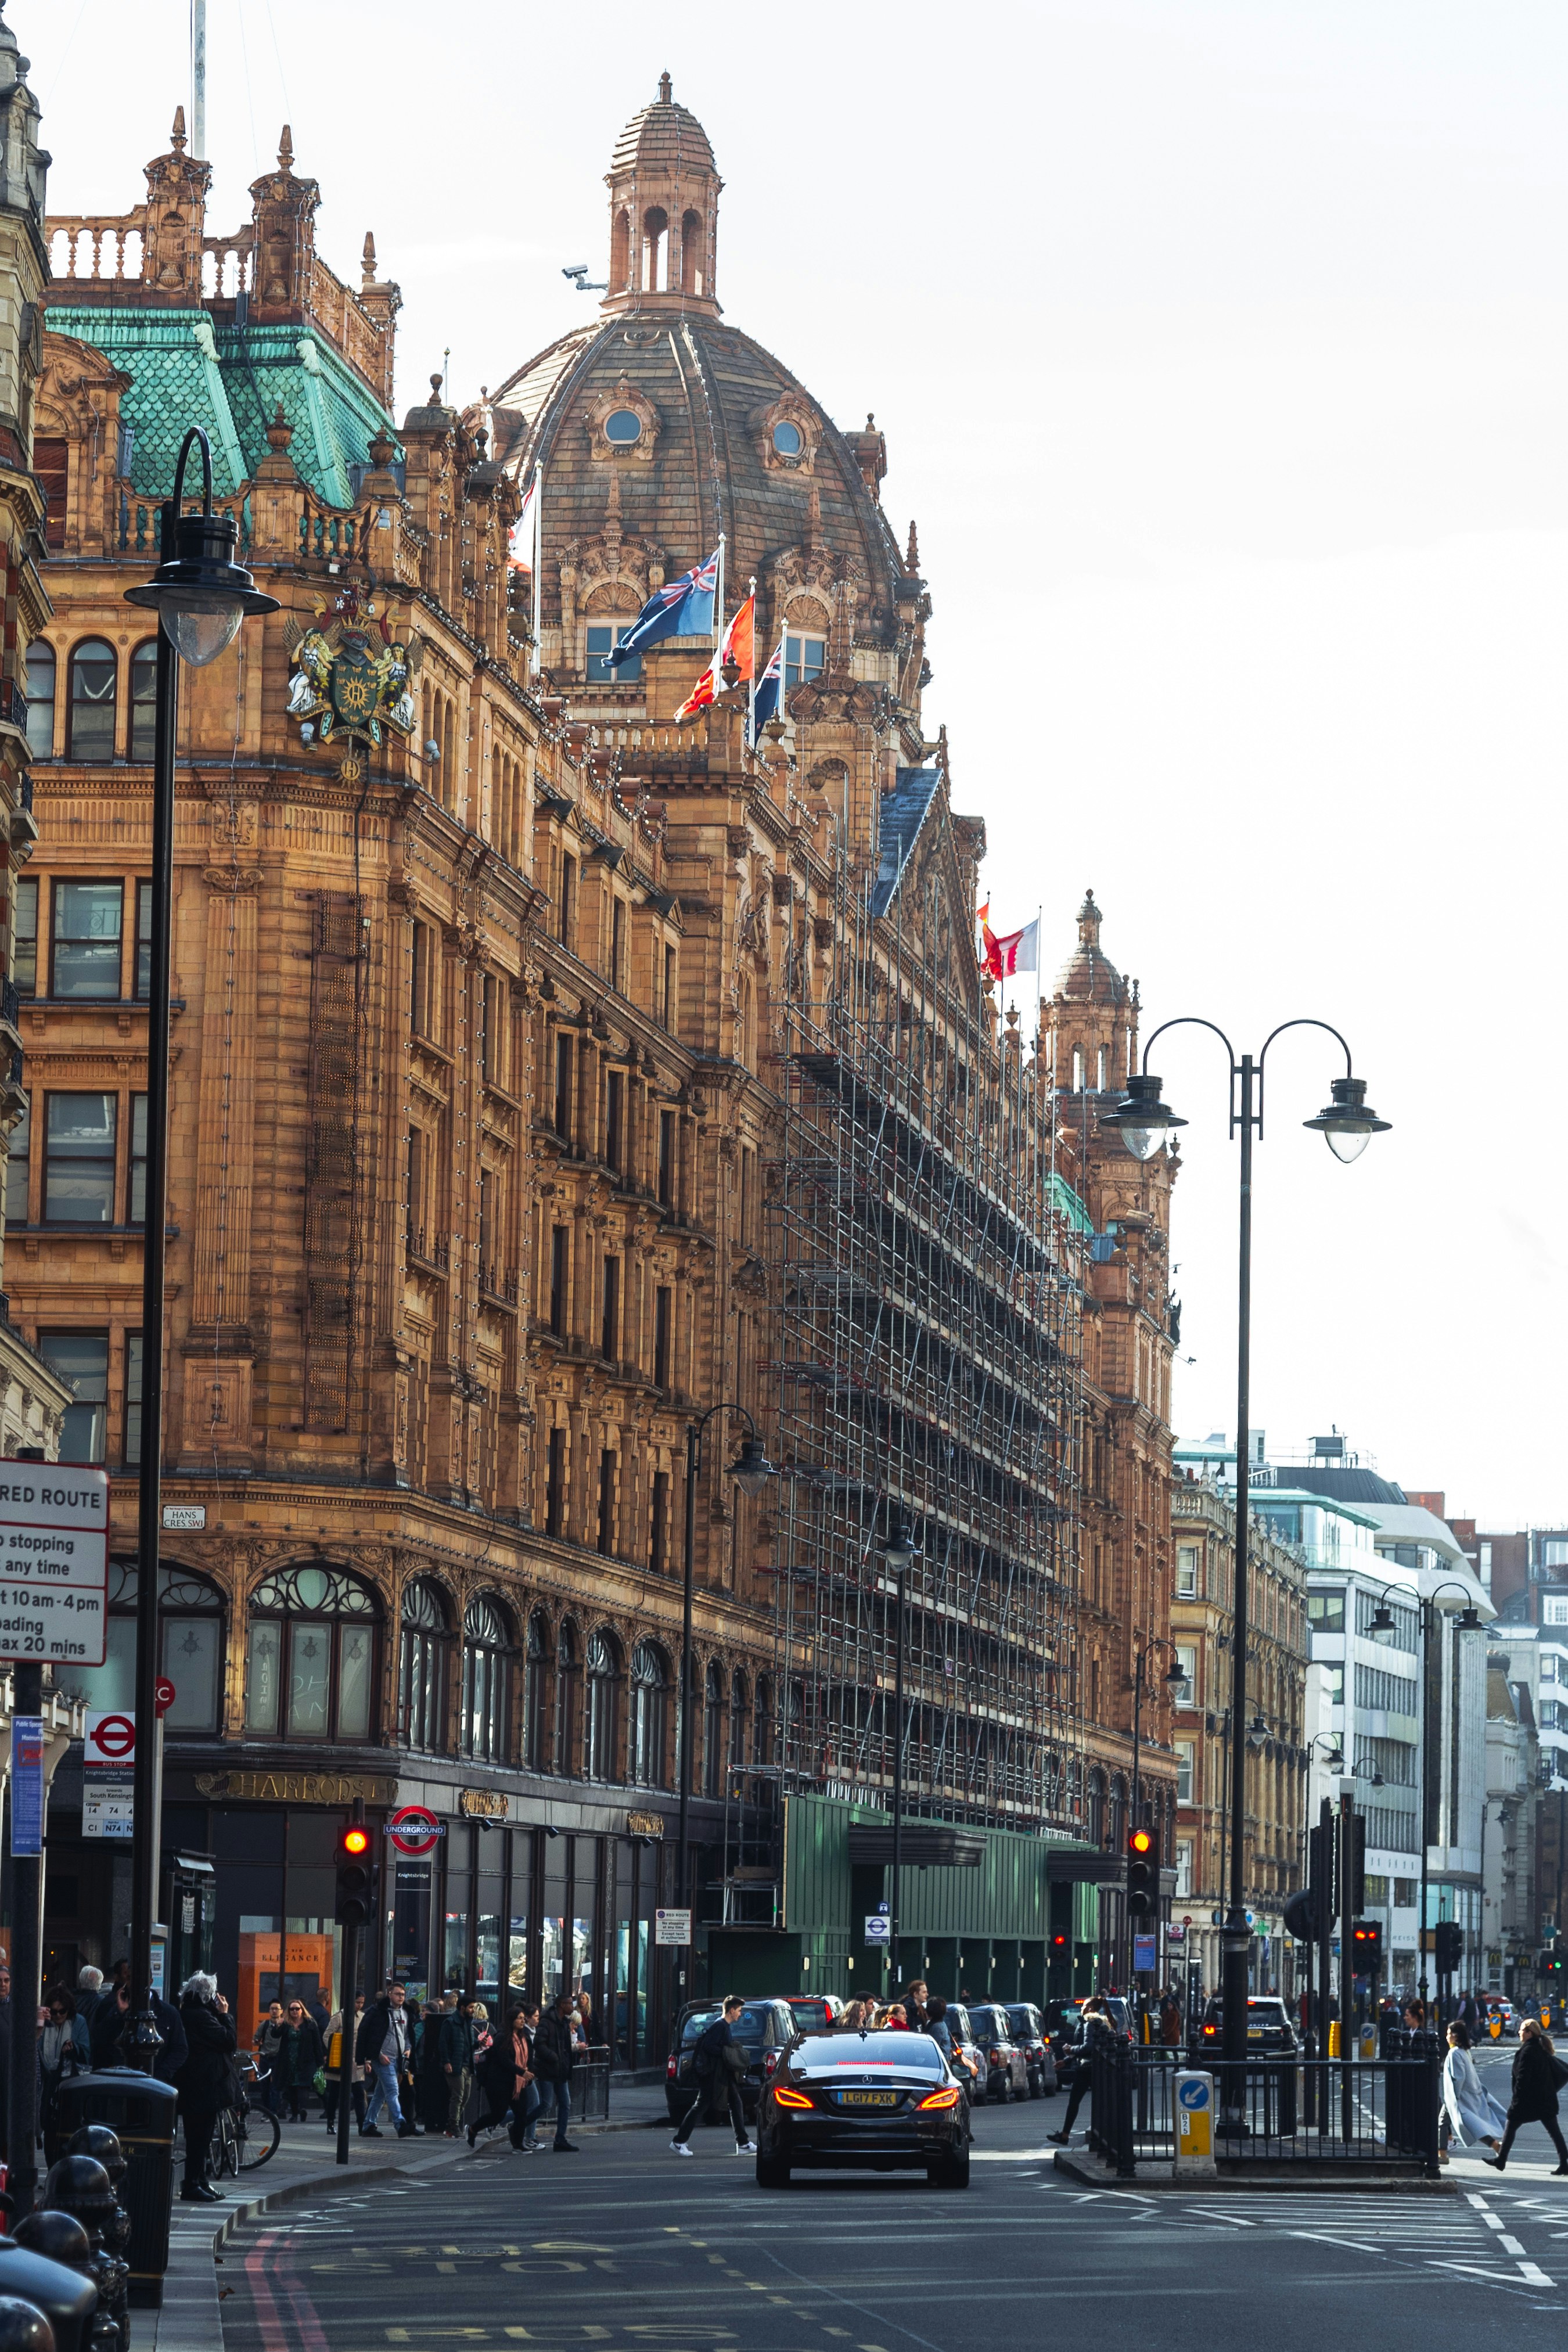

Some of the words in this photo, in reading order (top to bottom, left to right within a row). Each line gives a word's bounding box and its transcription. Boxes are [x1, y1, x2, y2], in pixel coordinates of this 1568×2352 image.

[0, 1485, 34, 1503] RED
[41, 1488, 100, 1509] ROUTE
[9, 1534, 74, 1555] stopping
[5, 1560, 31, 1576] any
[37, 1559, 70, 1576] time
[24, 1636, 45, 1652] 20
[51, 1639, 85, 1655] mins
[234, 1774, 365, 1801] HARRODS
[386, 1826, 443, 1834] UNDERGROUND
[846, 2093, 870, 2103] LG17
[872, 2094, 892, 2103] FXK
[384, 2324, 740, 2343] BUS
